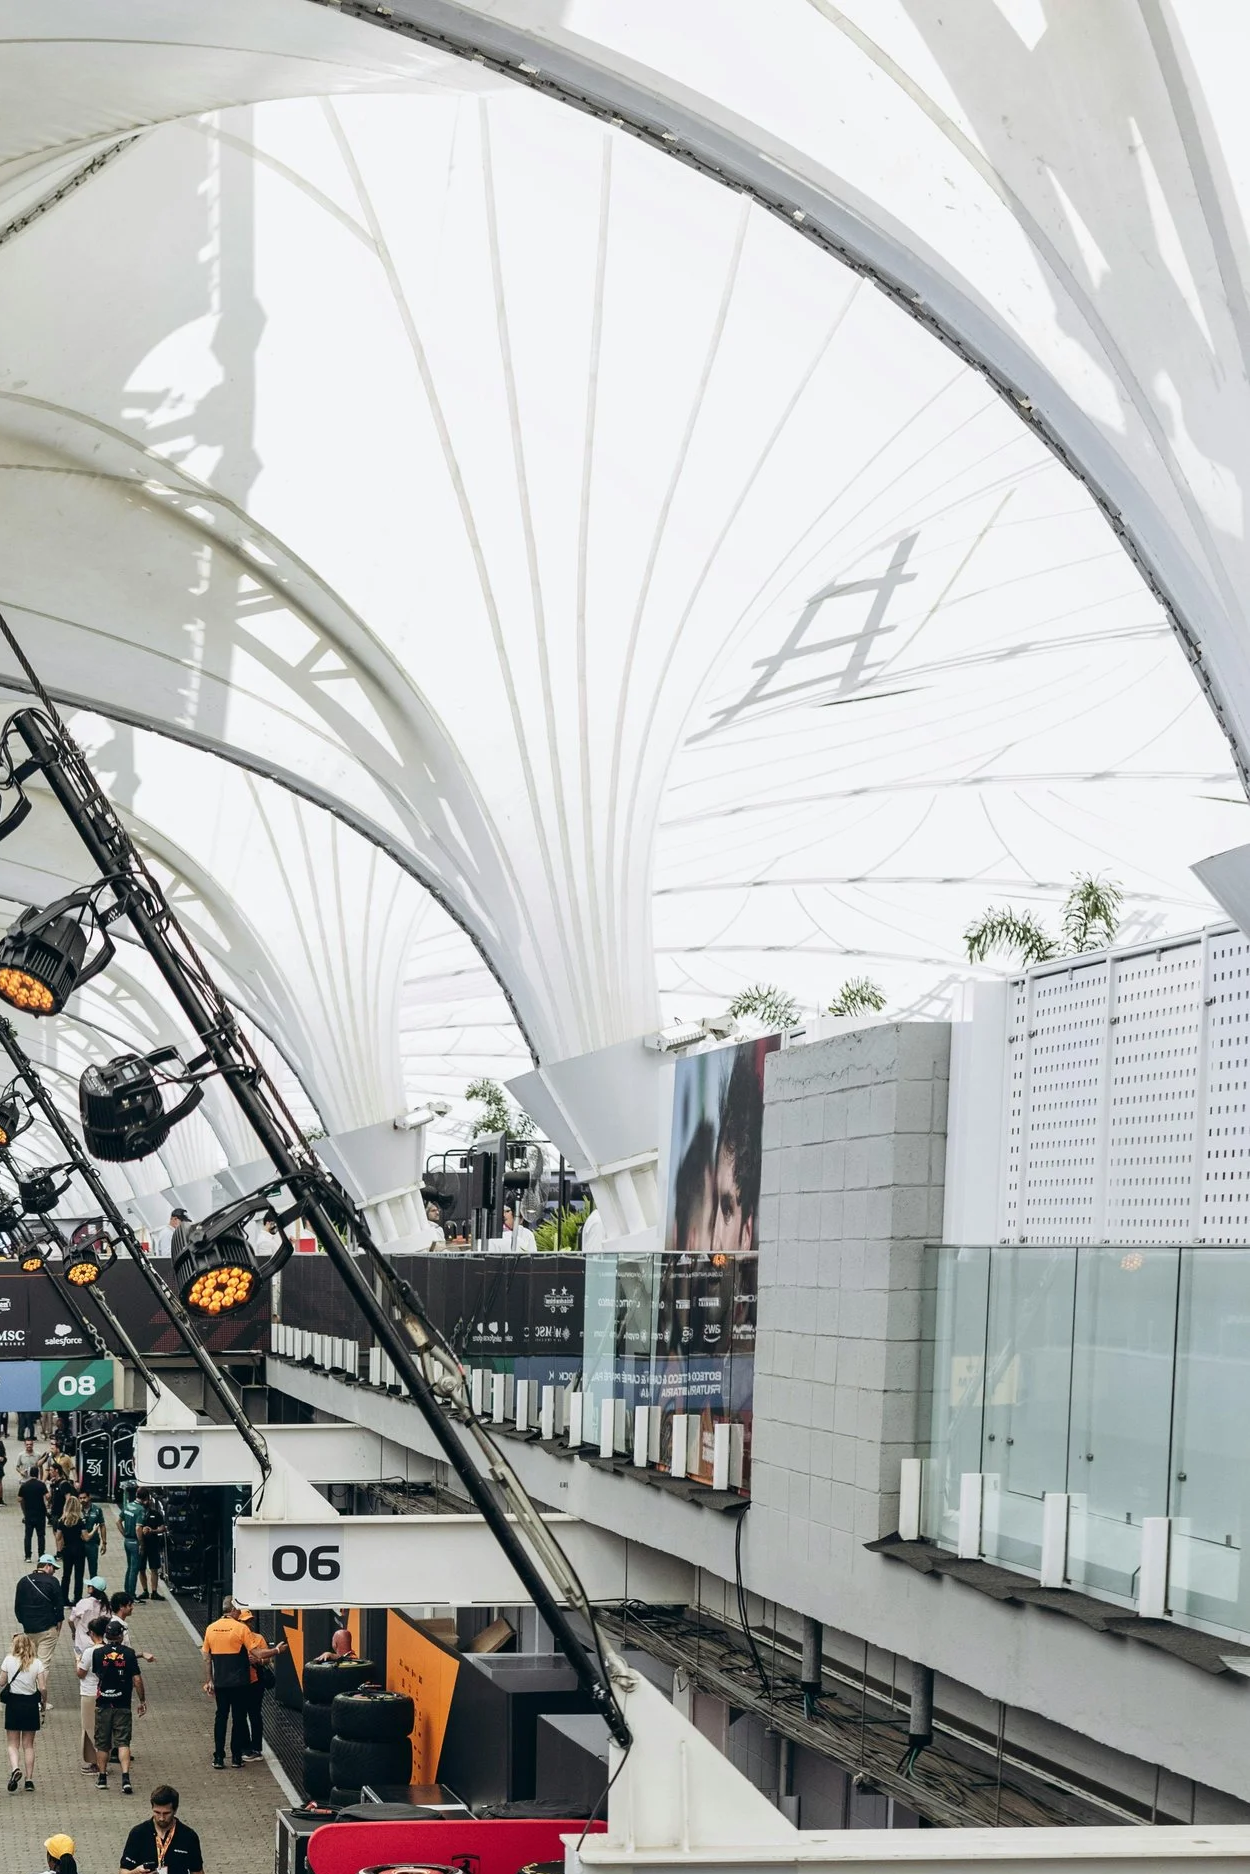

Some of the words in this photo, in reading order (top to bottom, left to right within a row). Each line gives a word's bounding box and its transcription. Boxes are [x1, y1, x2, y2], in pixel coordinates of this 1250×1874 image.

[44, 1337, 83, 1347] salesforce
[58, 1375, 96, 1396] 08
[86, 1459, 104, 1477] 31
[157, 1445, 200, 1470] 07
[271, 1545, 342, 1582] 06
